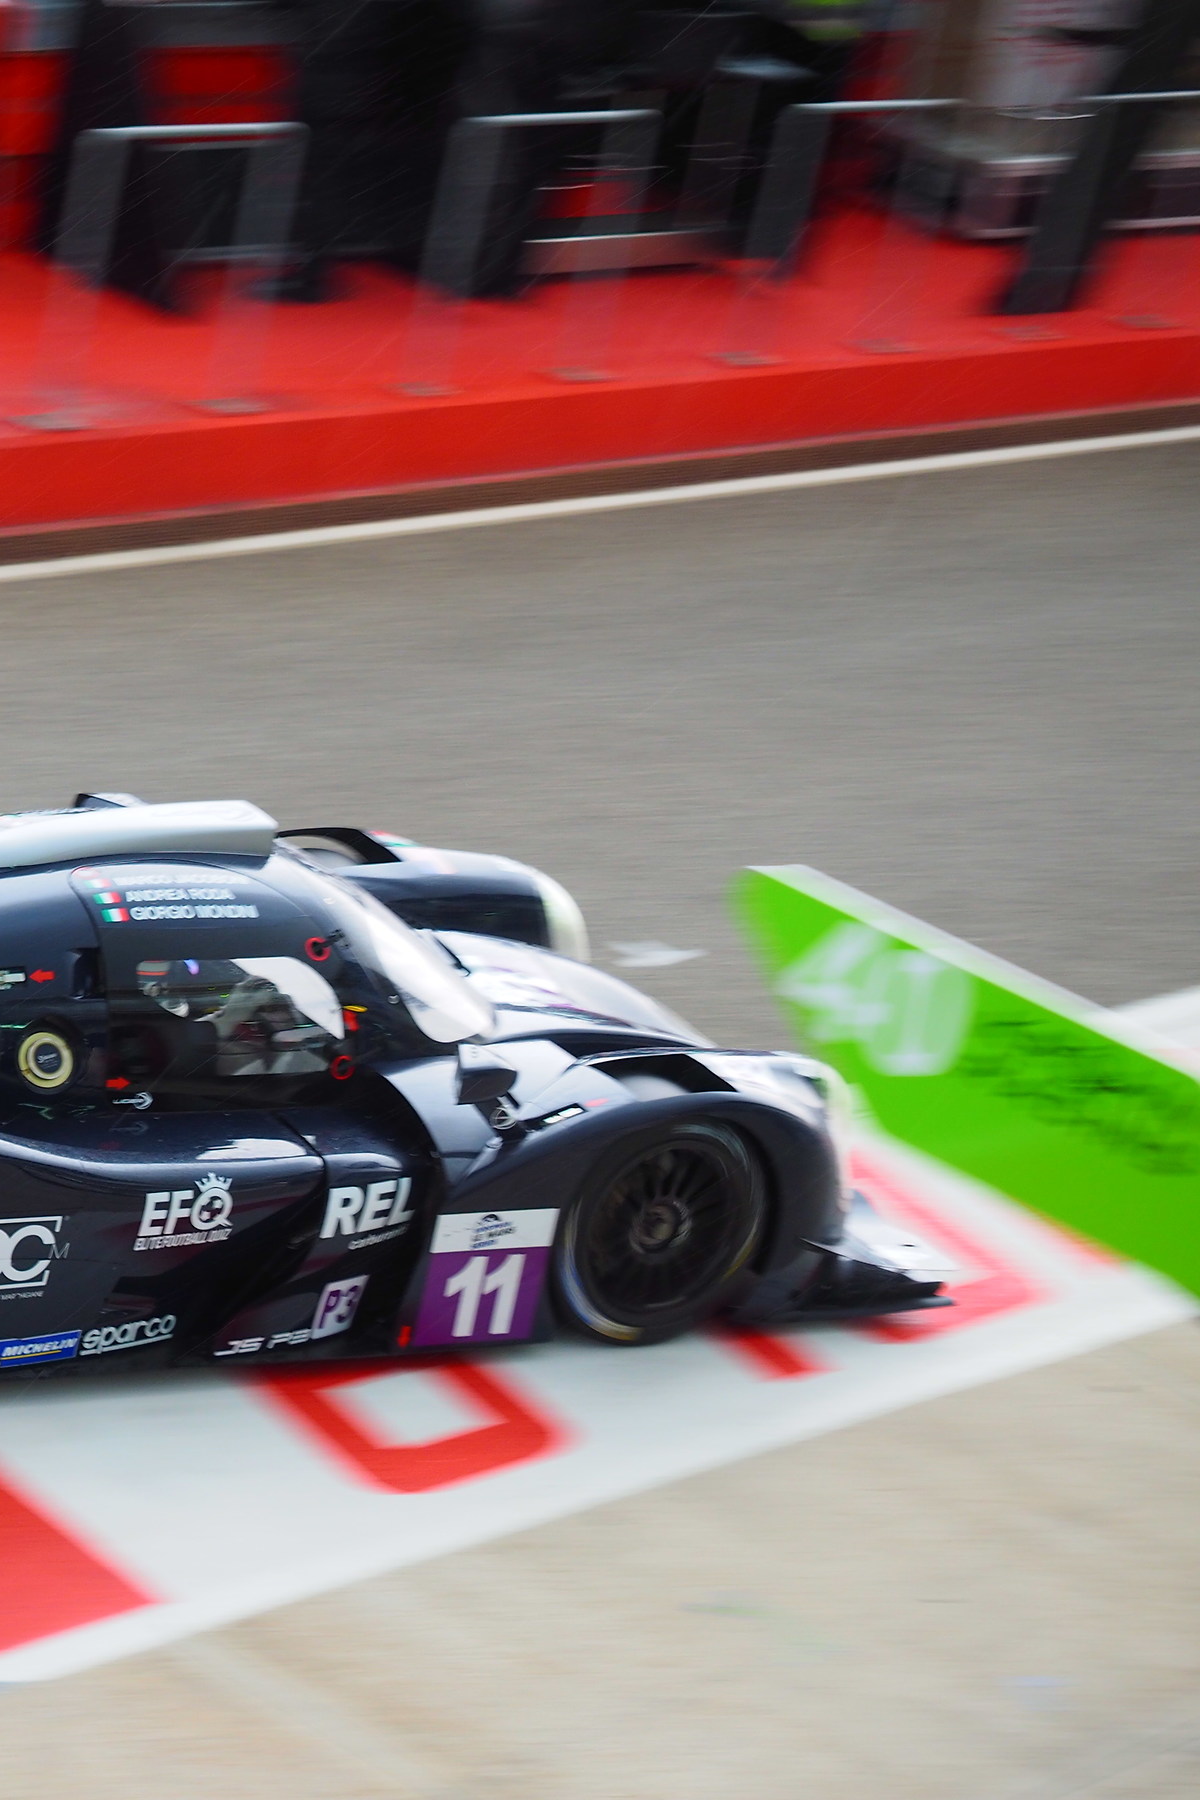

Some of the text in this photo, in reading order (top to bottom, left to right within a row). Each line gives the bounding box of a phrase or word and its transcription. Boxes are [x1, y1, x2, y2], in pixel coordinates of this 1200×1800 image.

[126, 888, 189, 902] ANDREA
[130, 905, 196, 920] GIORGIO
[137, 1187, 233, 1237] EFQ
[319, 1177, 416, 1239] REL
[319, 1285, 361, 1329] P3
[443, 1253, 527, 1338] 11
[2, 1338, 78, 1356] MICHELIN
[82, 1315, 176, 1351] sparco
[213, 1337, 265, 1356] JS
